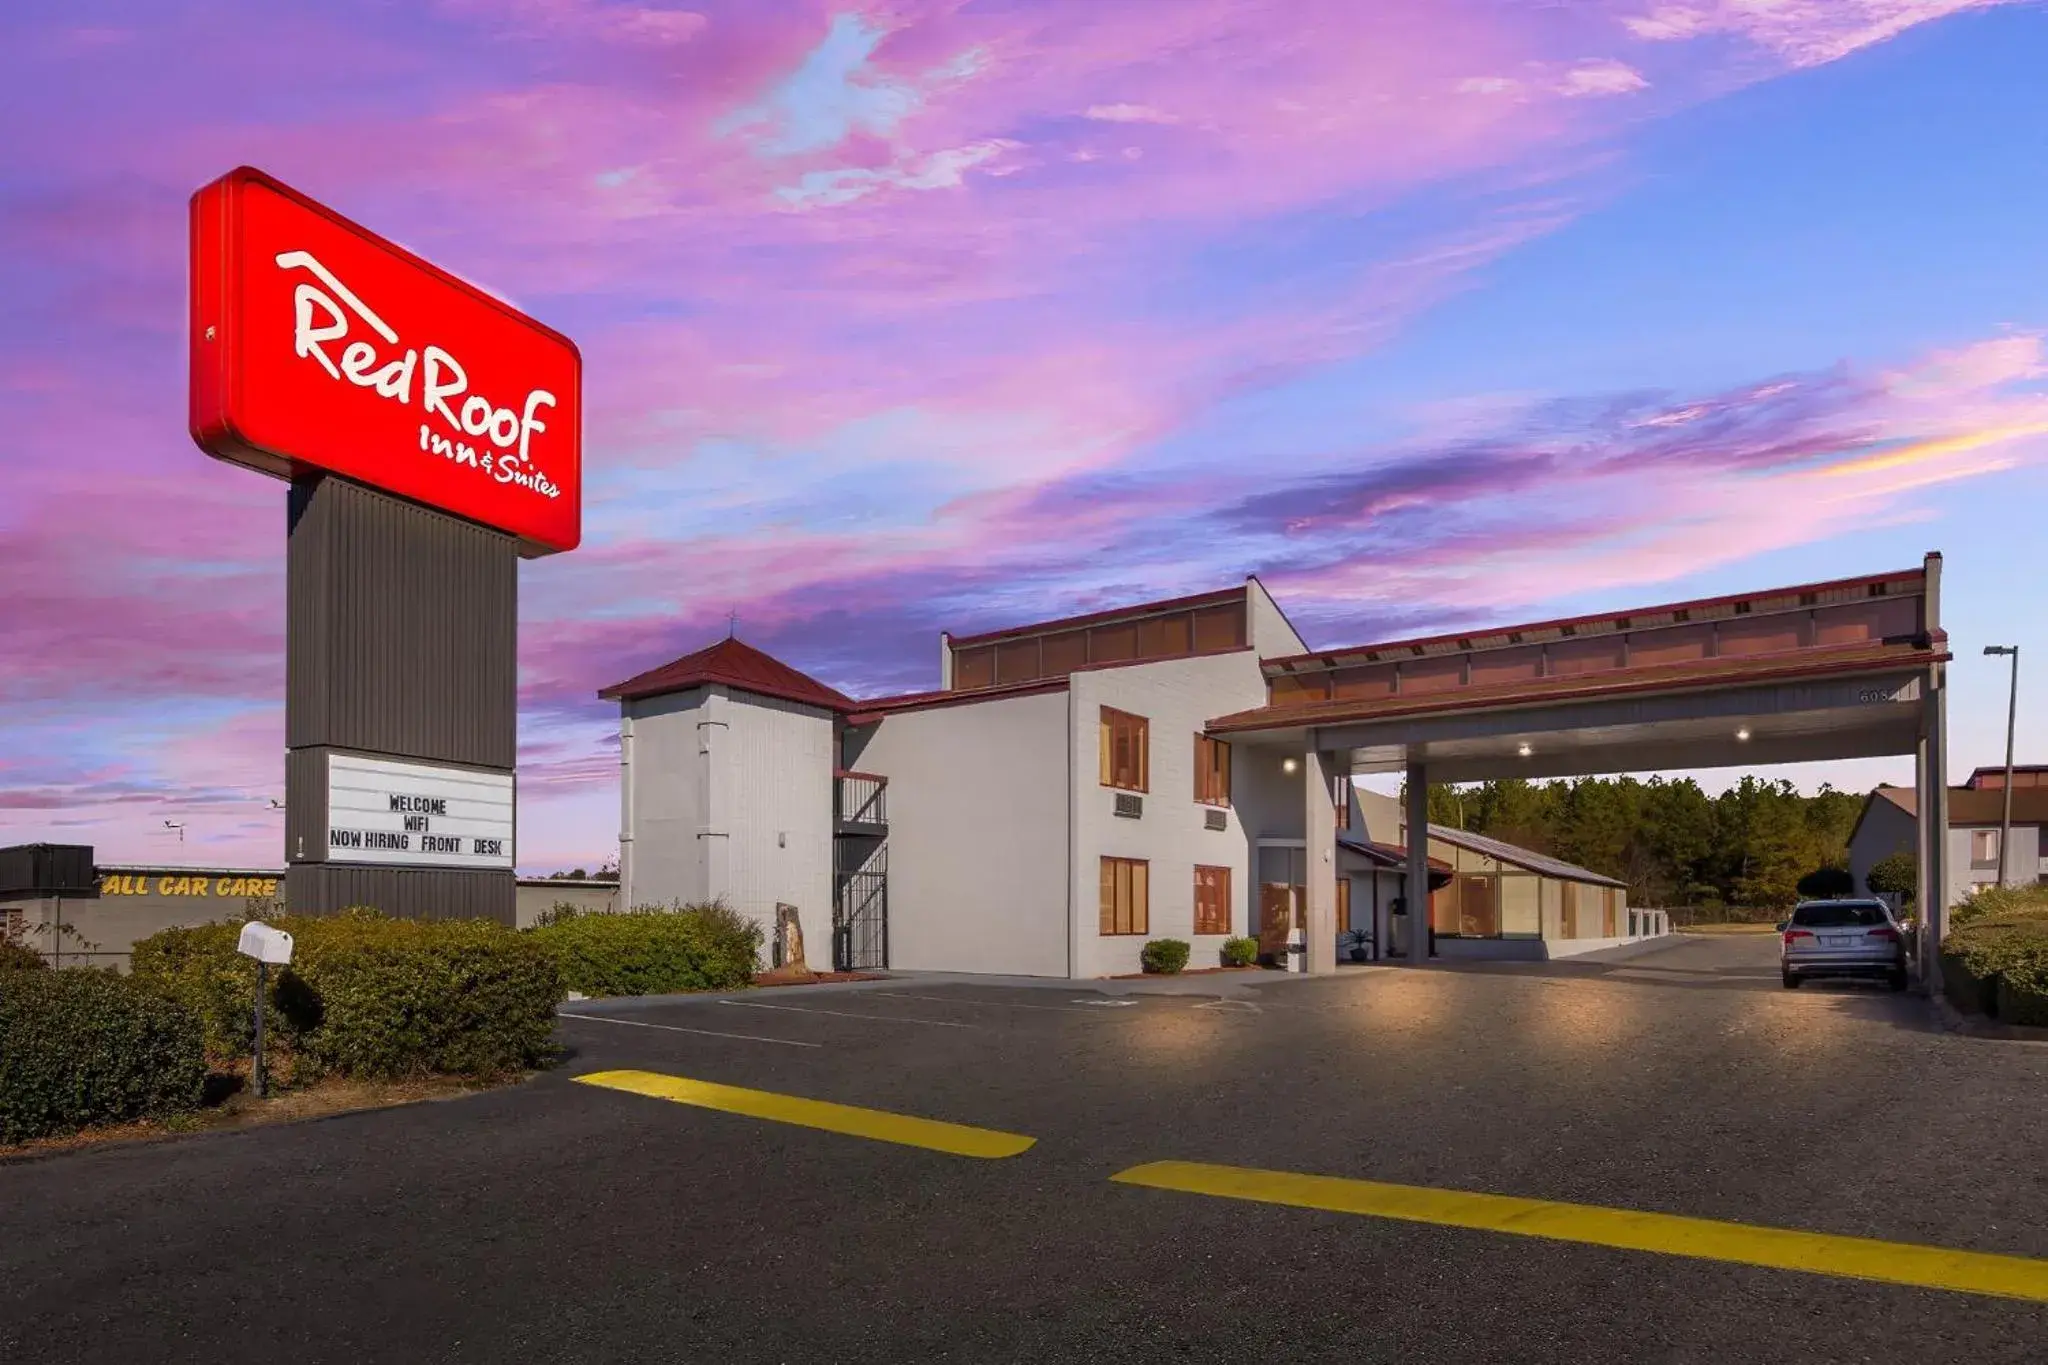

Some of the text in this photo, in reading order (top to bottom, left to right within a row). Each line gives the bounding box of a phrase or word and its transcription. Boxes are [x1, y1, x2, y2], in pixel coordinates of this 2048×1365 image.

[294, 284, 557, 462] Red Roof
[419, 424, 560, 498] Inn & Suites
[389, 794, 446, 814] WELCOME
[404, 815, 429, 832] WIFI
[330, 830, 501, 855] NOW HIRING FRONT DESK
[102, 875, 277, 897] ALL CAR CARE
